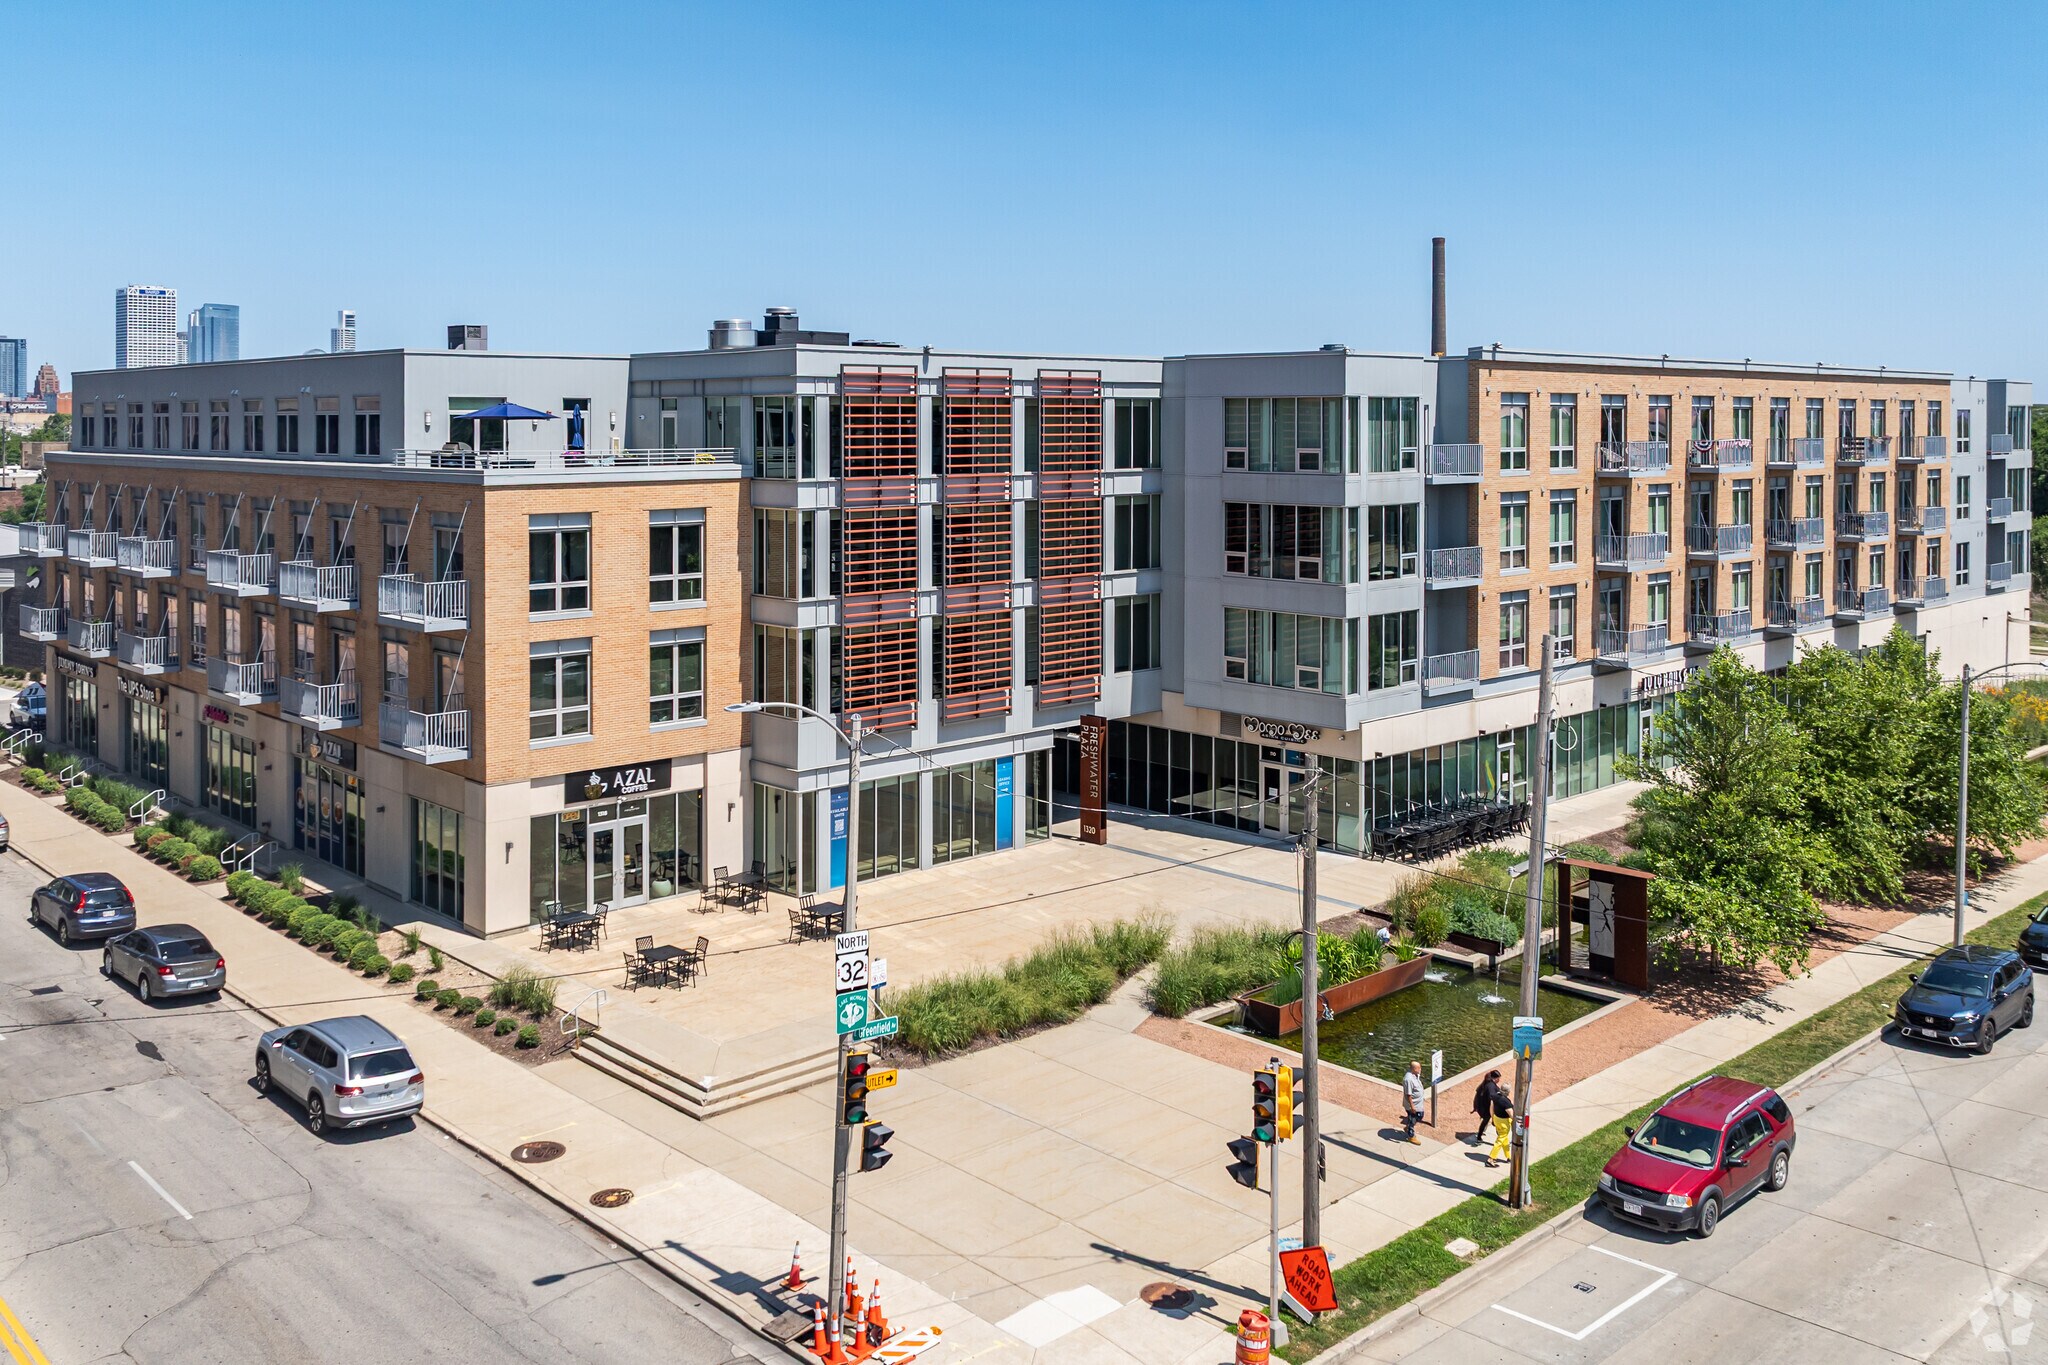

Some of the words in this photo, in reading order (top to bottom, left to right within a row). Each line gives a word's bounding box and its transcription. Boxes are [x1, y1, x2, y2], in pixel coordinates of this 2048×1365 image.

[75, 662, 93, 678] JOHN'S
[117, 676, 127, 692] The
[128, 680, 139, 697] UPS
[139, 683, 155, 702] Store
[322, 740, 342, 759] AZAL
[1081, 724, 1089, 759] PLAZA
[1090, 726, 1098, 798] FRESHWATER
[613, 767, 656, 788] AZAL
[621, 783, 649, 794] COFFEE
[1083, 825, 1096, 835] 1320
[837, 934, 868, 950] NORTH
[841, 960, 864, 983] 32
[838, 997, 848, 1008] LAKE
[850, 995, 867, 1003] MICHIGAN
[859, 1020, 891, 1038] Greenfield
[867, 1075, 885, 1088] UTLET
[1302, 1253, 1326, 1280] ROAD
[1296, 1264, 1322, 1294] WORK
[1289, 1276, 1318, 1306] AHEAD
